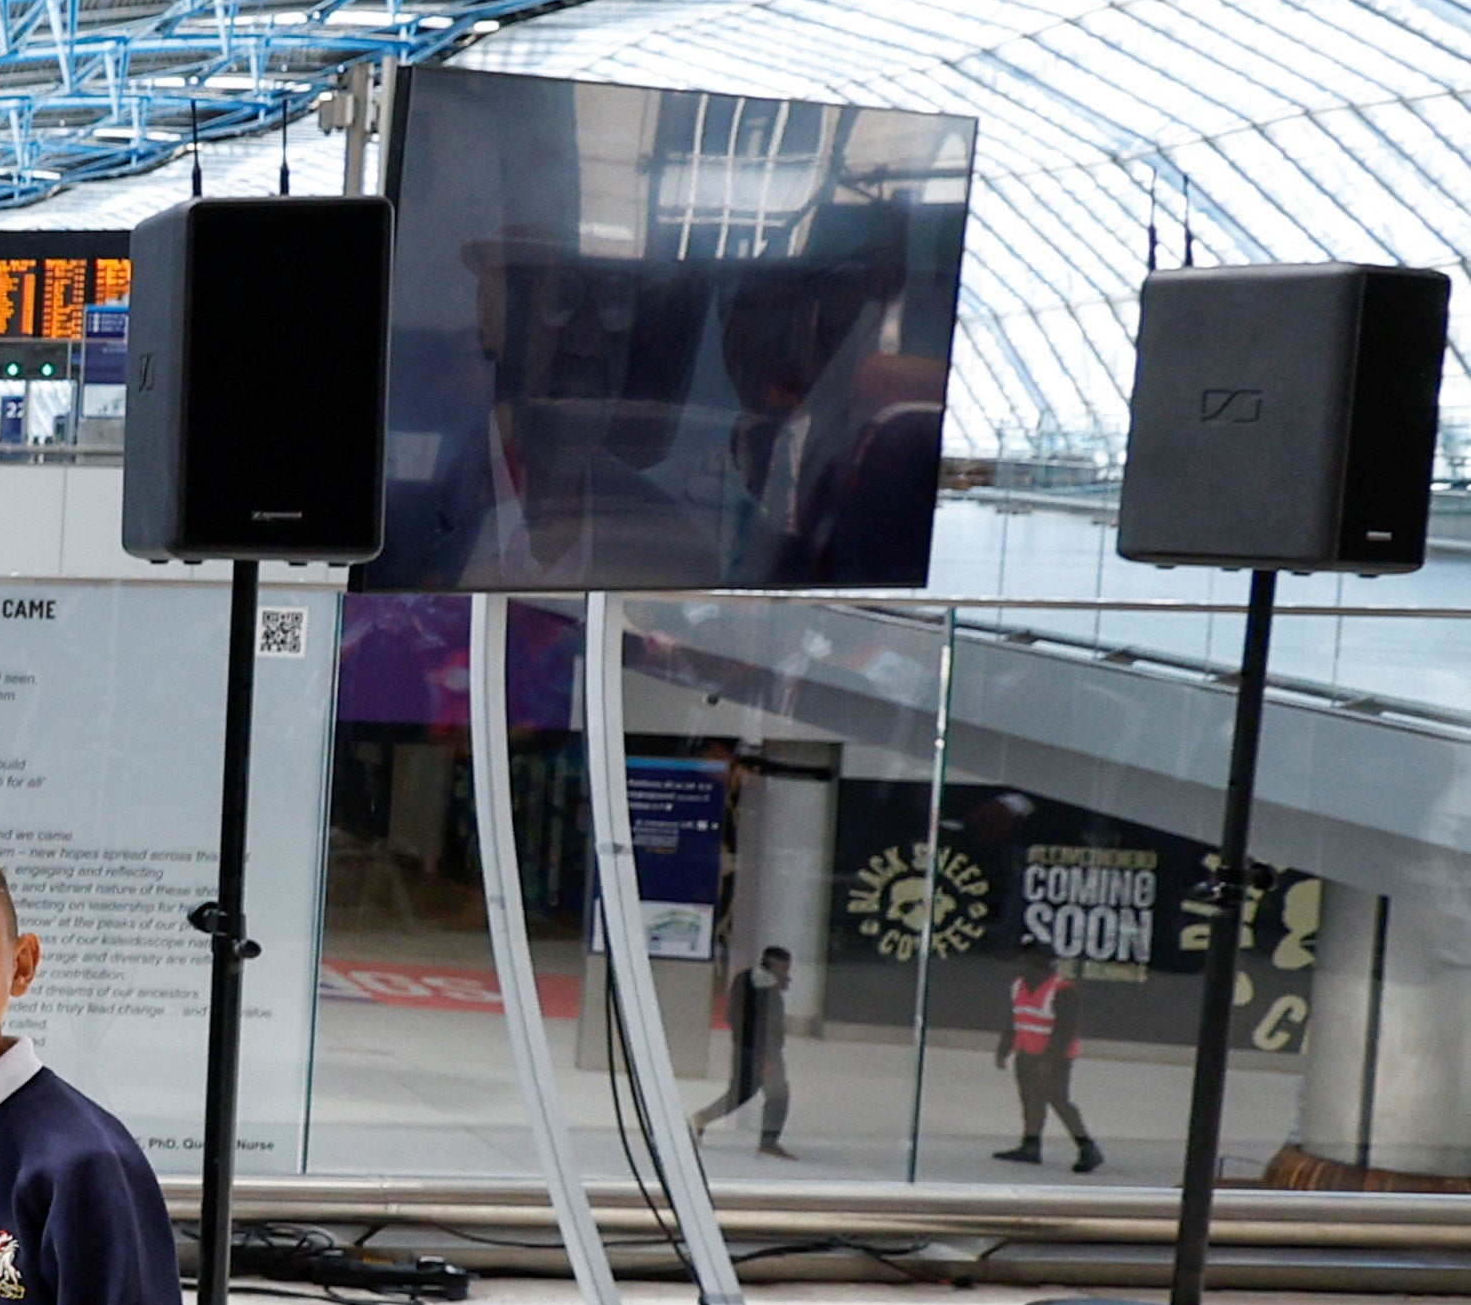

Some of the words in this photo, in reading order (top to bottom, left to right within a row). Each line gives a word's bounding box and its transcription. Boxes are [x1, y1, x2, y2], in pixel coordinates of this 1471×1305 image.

[2, 599, 57, 619] CAME
[15, 831, 33, 842] we
[30, 849, 57, 860] new
[59, 848, 100, 863] hopes
[103, 848, 147, 864] spread
[14, 865, 75, 879] engaging
[78, 865, 104, 878] and
[847, 845, 909, 913] BLACK
[912, 842, 989, 897] SEEP
[49, 881, 94, 894] vibrant
[1022, 863, 1157, 908] COMING
[878, 916, 986, 963] COFEE
[1021, 901, 1154, 963] SOON
[236, 1138, 275, 1152] Nurse
